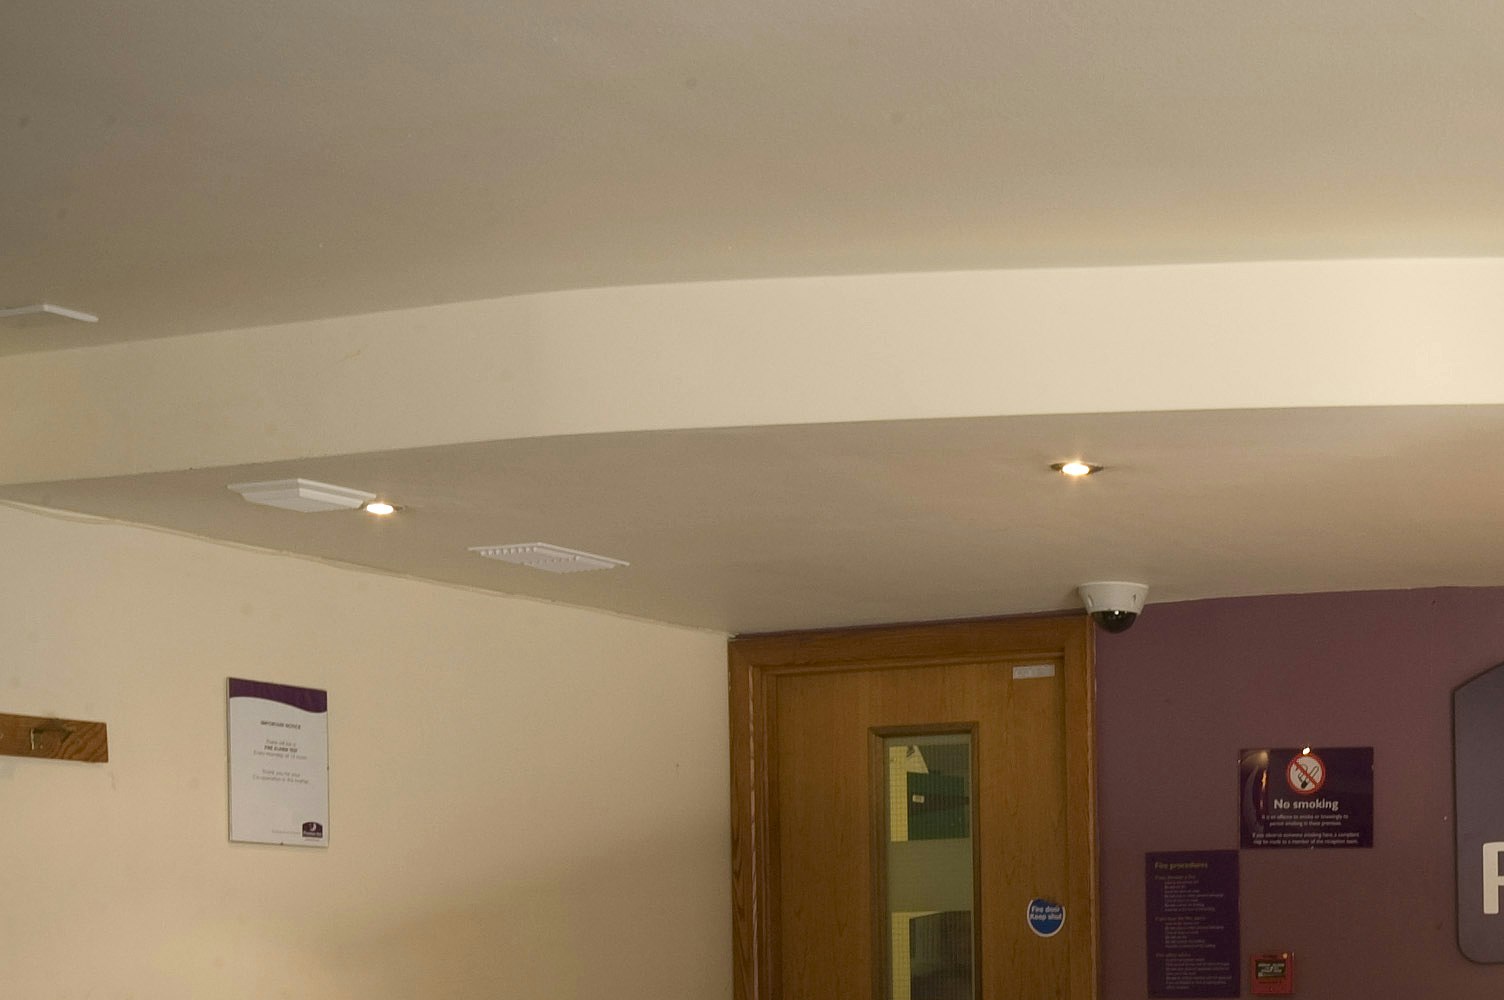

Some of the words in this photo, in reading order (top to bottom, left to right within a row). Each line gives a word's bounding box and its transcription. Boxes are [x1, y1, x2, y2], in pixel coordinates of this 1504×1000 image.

[1273, 799, 1290, 809] No
[1293, 798, 1339, 811] smoking
[1030, 913, 1047, 921] Keep
